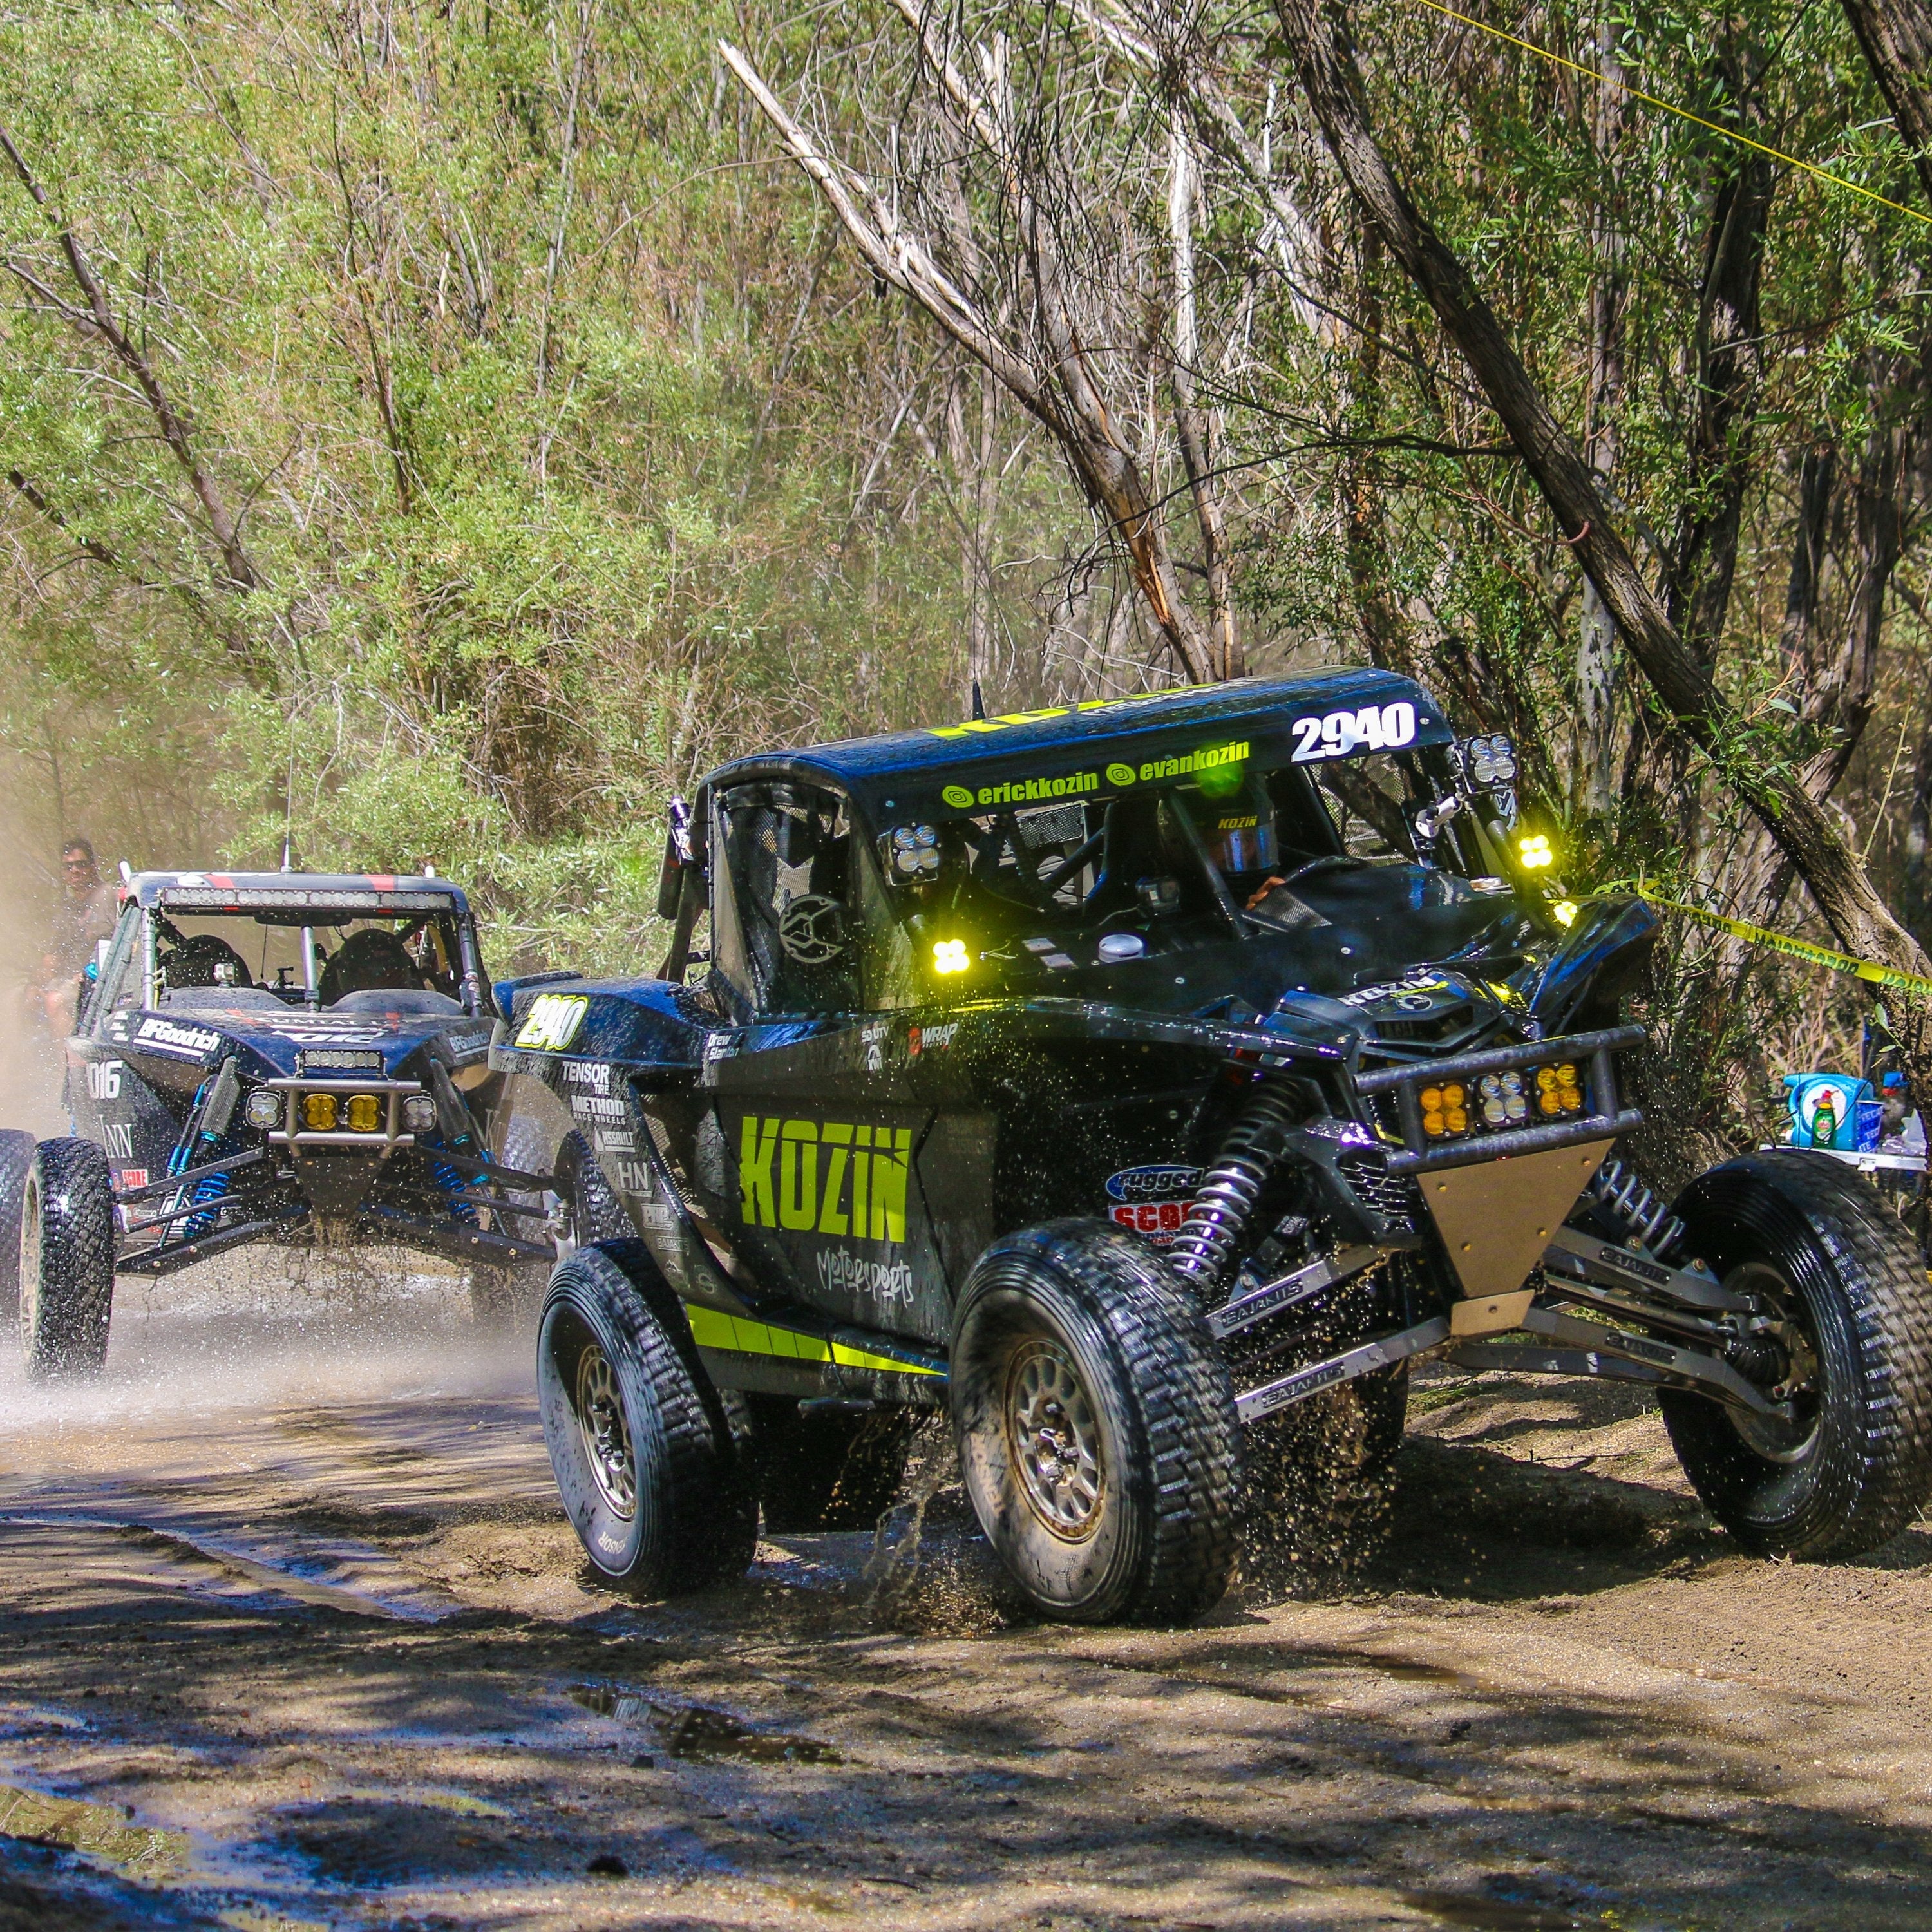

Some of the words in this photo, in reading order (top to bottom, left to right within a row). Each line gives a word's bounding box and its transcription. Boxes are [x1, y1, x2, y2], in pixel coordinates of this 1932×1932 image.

[1291, 701, 1416, 763] 2940
[978, 772, 1099, 806] erickkozin
[1139, 741, 1251, 781] evankozin
[1218, 815, 1258, 829] KOZIN
[1337, 976, 1437, 1006] KOZIN
[515, 994, 589, 1051] 2940
[922, 1023, 958, 1045] WRAP
[137, 1018, 220, 1052] BFGoodrich
[708, 1034, 732, 1046] Drew
[562, 1061, 610, 1084] TENSOR
[594, 1084, 610, 1095] TIRE
[571, 1095, 625, 1116] METHOD
[573, 1112, 592, 1121] RACE
[594, 1115, 625, 1125] WHEELS
[602, 1131, 634, 1146] ASSAULT
[618, 1162, 648, 1190] HN
[739, 1116, 911, 1243] KOZIN
[1117, 1168, 1204, 1192] rugged
[816, 1245, 914, 1309] Motorsports
